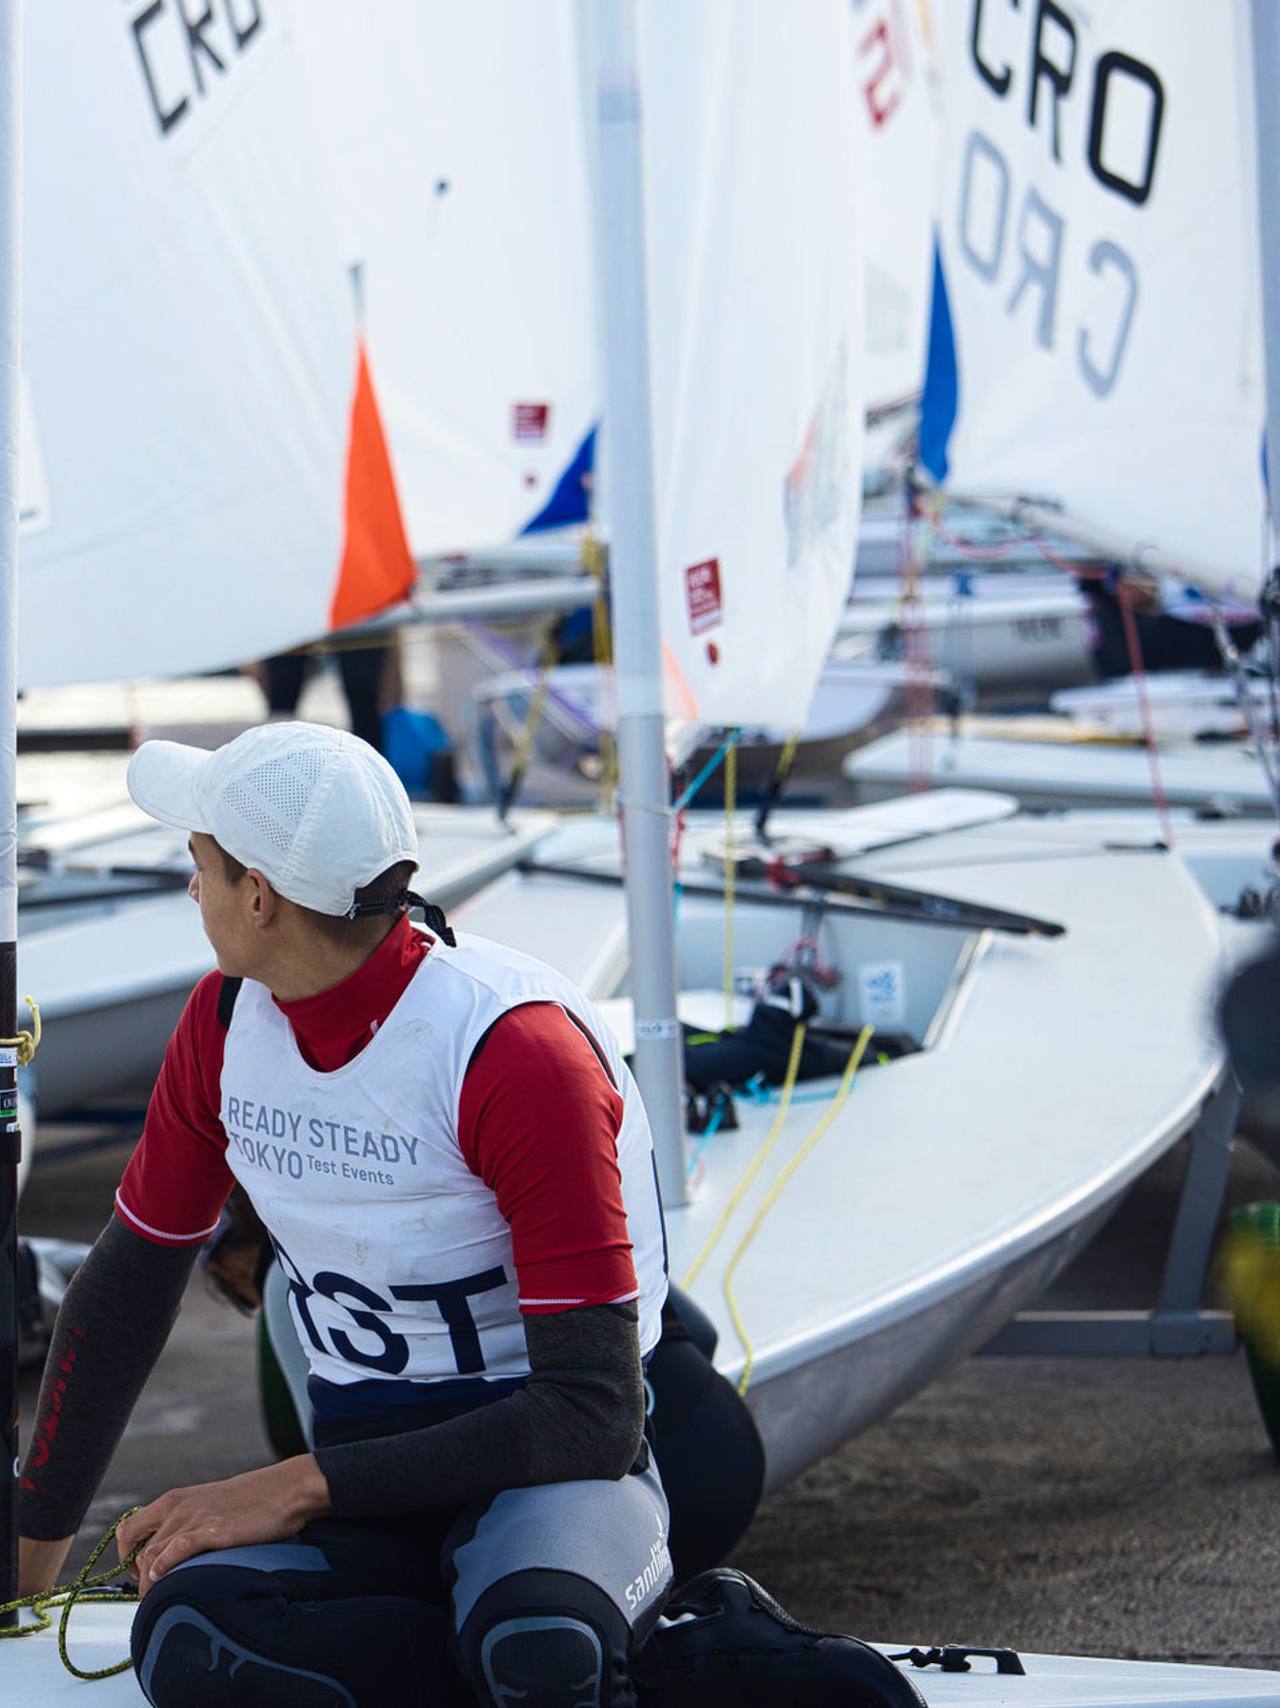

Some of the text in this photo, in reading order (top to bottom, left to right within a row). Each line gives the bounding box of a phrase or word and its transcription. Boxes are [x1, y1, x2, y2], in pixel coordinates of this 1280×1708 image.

[970, 0, 1164, 207] CRO
[228, 1096, 419, 1165] READY STEADY
[230, 1131, 394, 1186] TOKYO Test Events
